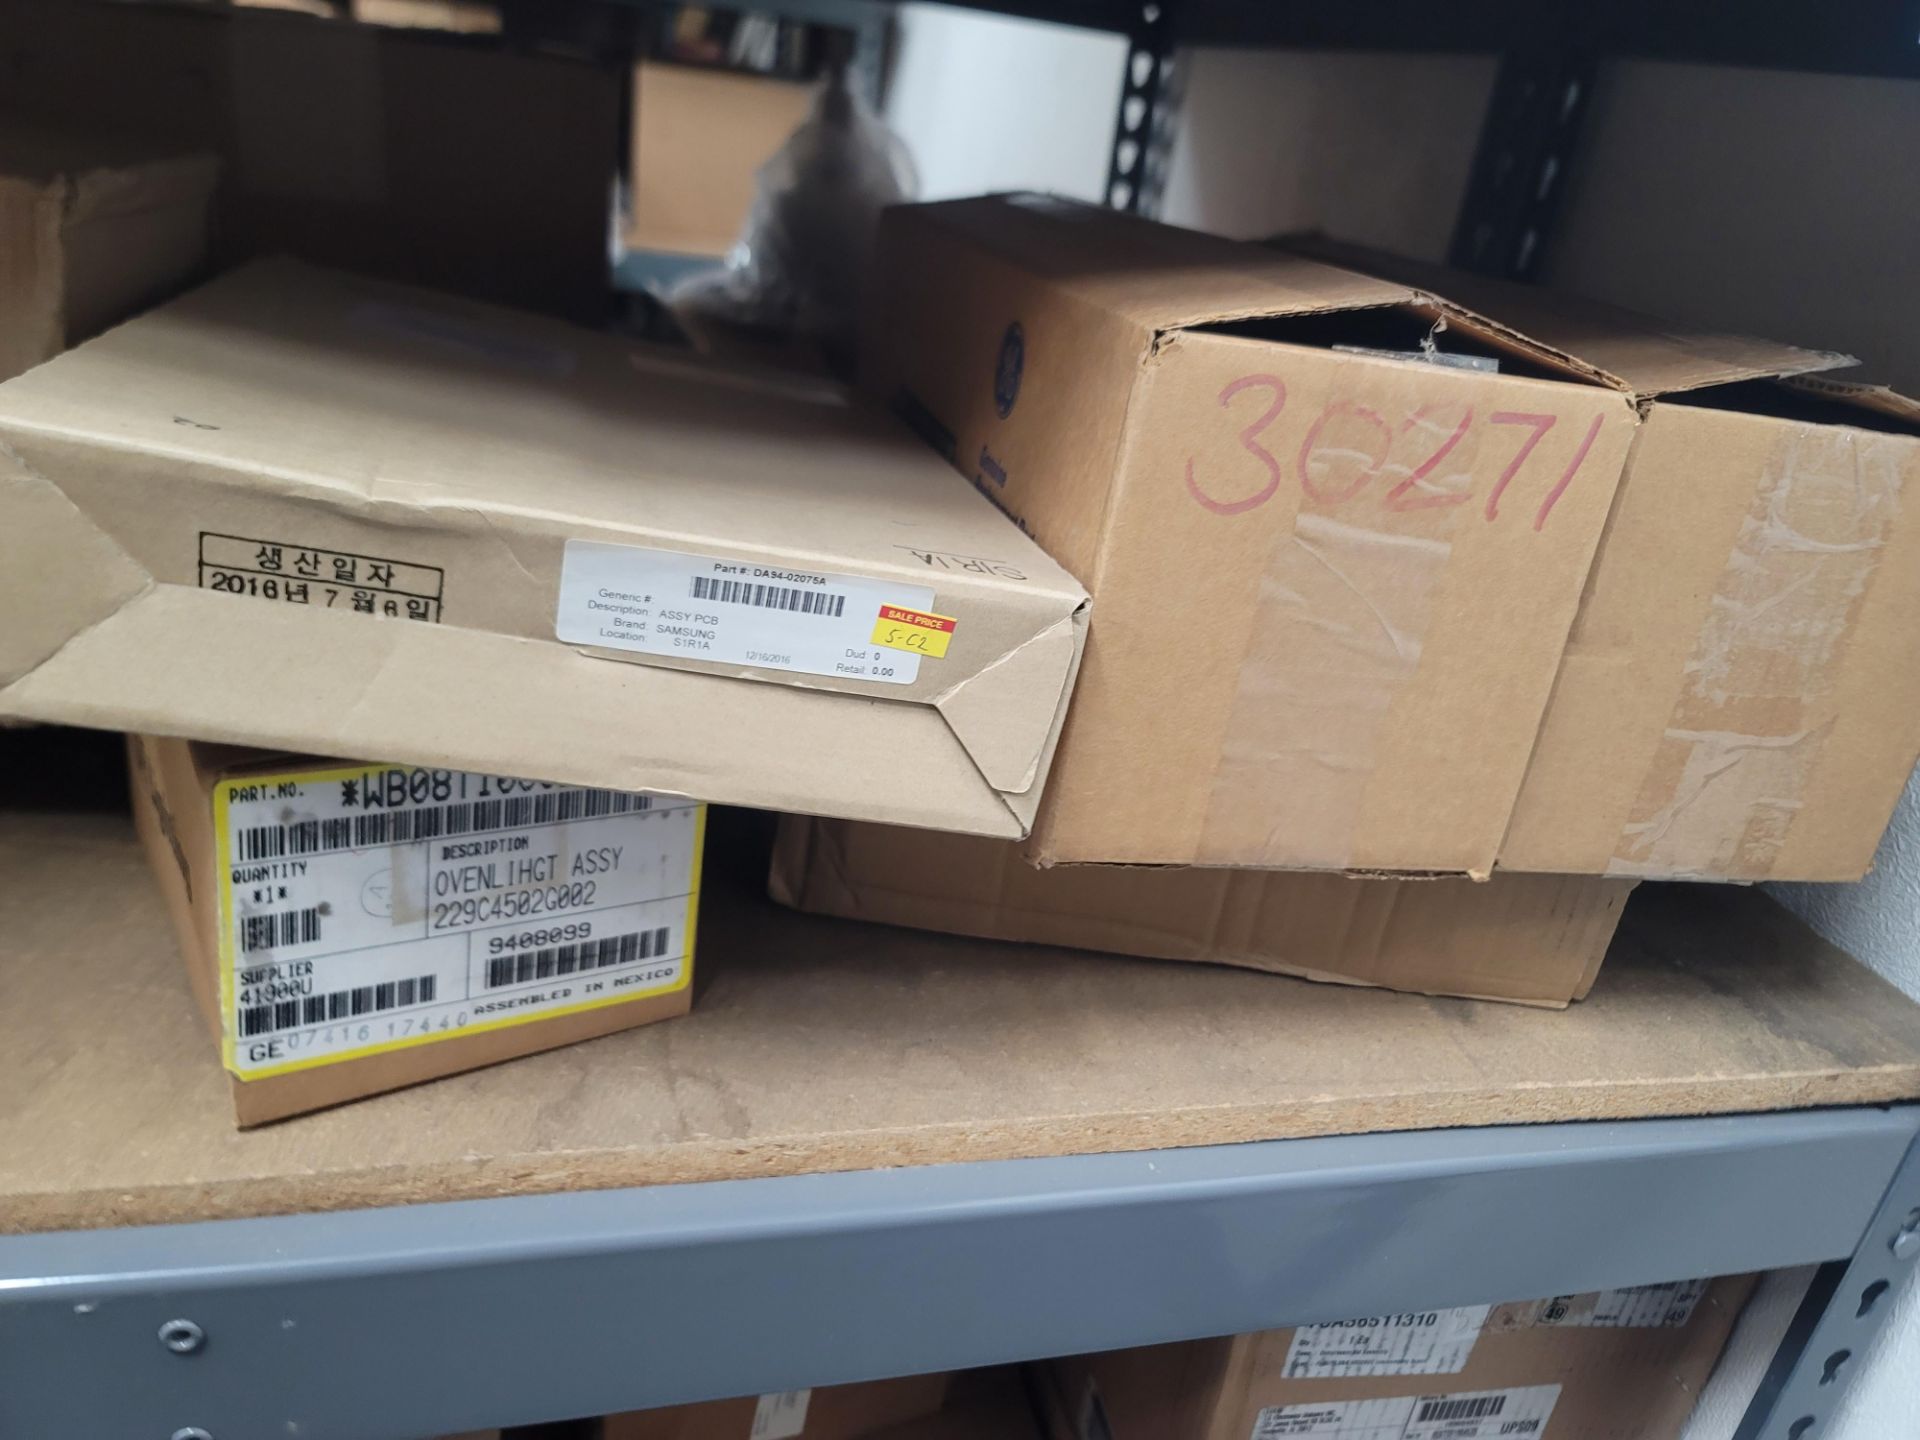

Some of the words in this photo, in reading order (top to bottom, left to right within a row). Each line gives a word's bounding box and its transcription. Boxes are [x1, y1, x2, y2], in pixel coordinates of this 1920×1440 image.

[1183, 373, 1605, 532] 30271
[256, 544, 395, 588] 생산일자
[713, 563, 737, 575] Part
[753, 568, 827, 586] DA94-02075A
[598, 588, 642, 603] Generic
[659, 610, 692, 622] ASSY
[694, 614, 720, 626] PCB
[888, 610, 914, 624] SALE
[913, 615, 944, 629] PRICE
[656, 624, 716, 641] SAMSUNG
[673, 637, 711, 651] S1R1A
[745, 650, 792, 665] 12/16/2016
[873, 652, 882, 661] 0
[871, 666, 895, 678] 0.00
[442, 836, 530, 860] DESCRIPTION
[232, 861, 308, 884] QUANTITY
[434, 854, 558, 897] OVENLIHGT
[572, 846, 624, 876] ASSY
[434, 880, 597, 930] 229C4502G002
[489, 921, 593, 954] 9408099
[240, 961, 314, 987] SUPPLIER
[473, 988, 573, 1015] ASSEMBLED
[585, 981, 604, 993] IN
[613, 968, 675, 987] MEXICO
[249, 1038, 285, 1063] GE
